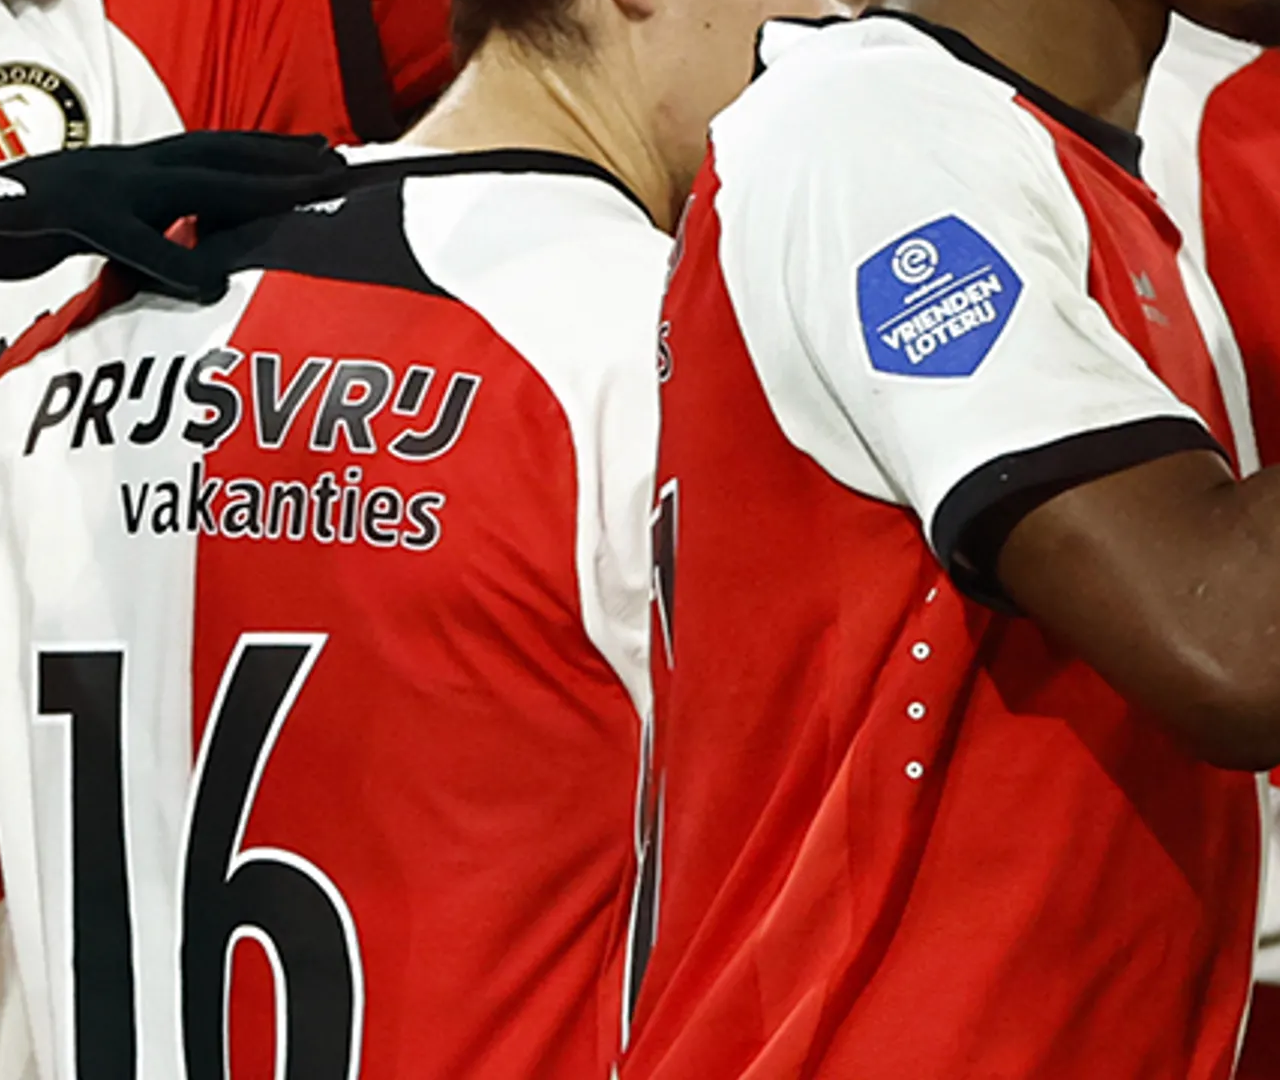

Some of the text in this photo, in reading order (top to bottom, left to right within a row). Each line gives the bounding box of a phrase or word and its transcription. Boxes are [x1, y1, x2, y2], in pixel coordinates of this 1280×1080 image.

[880, 272, 1003, 350] VRIENDEN
[119, 460, 446, 551] vakanties
[31, 631, 366, 1080] 16
